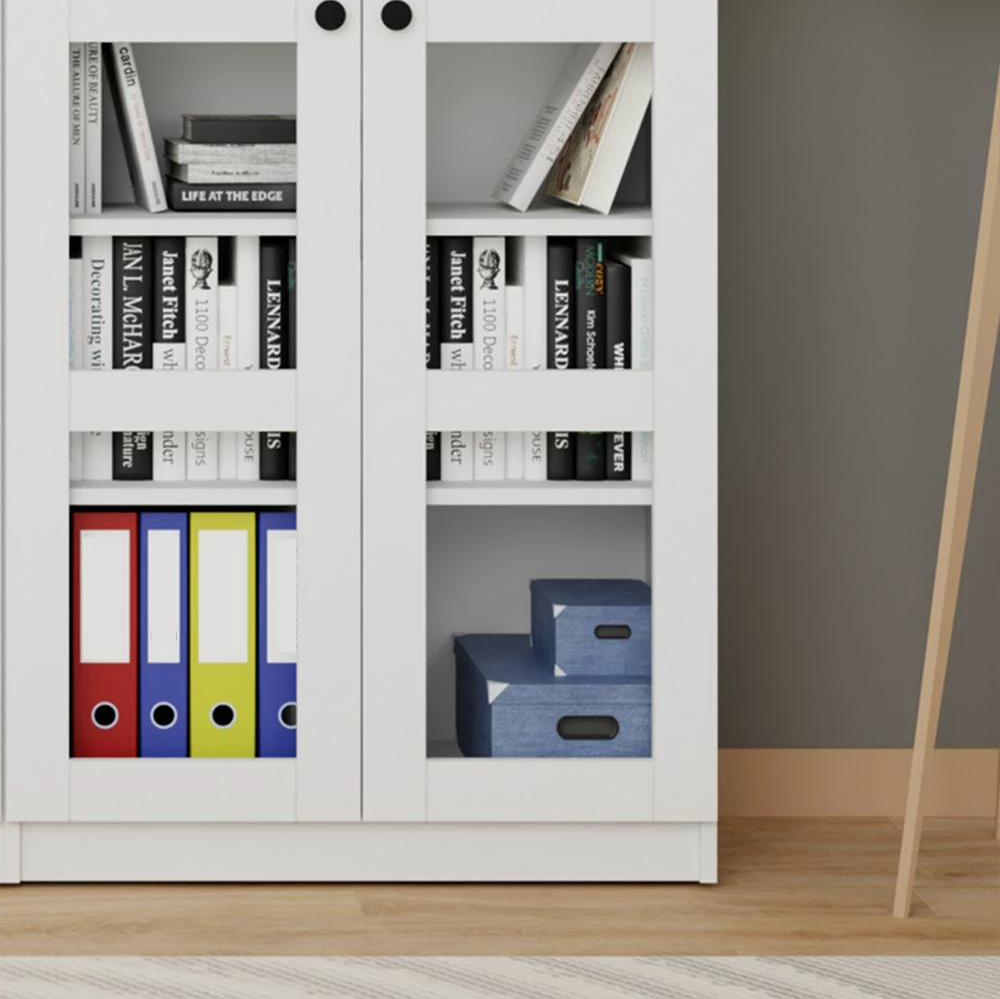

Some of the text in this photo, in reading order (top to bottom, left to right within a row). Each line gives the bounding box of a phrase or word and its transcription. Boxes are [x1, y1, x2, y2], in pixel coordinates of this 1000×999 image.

[72, 49, 80, 146] THE ALLURE OF MEN
[88, 66, 98, 125] OF BEAUTY
[119, 46, 137, 87] cardin
[182, 191, 283, 202] LIFE AT THE EDGE
[88, 259, 105, 345] Decorating
[162, 250, 178, 339] Janet Fitch
[267, 279, 281, 370] LENNARD
[450, 250, 466, 339] Janet Fitch
[555, 279, 569, 370] LENNARD
[586, 309, 596, 329] Kim
[195, 300, 208, 370] 1100 Deco
[483, 300, 496, 370] 1100 Deco
